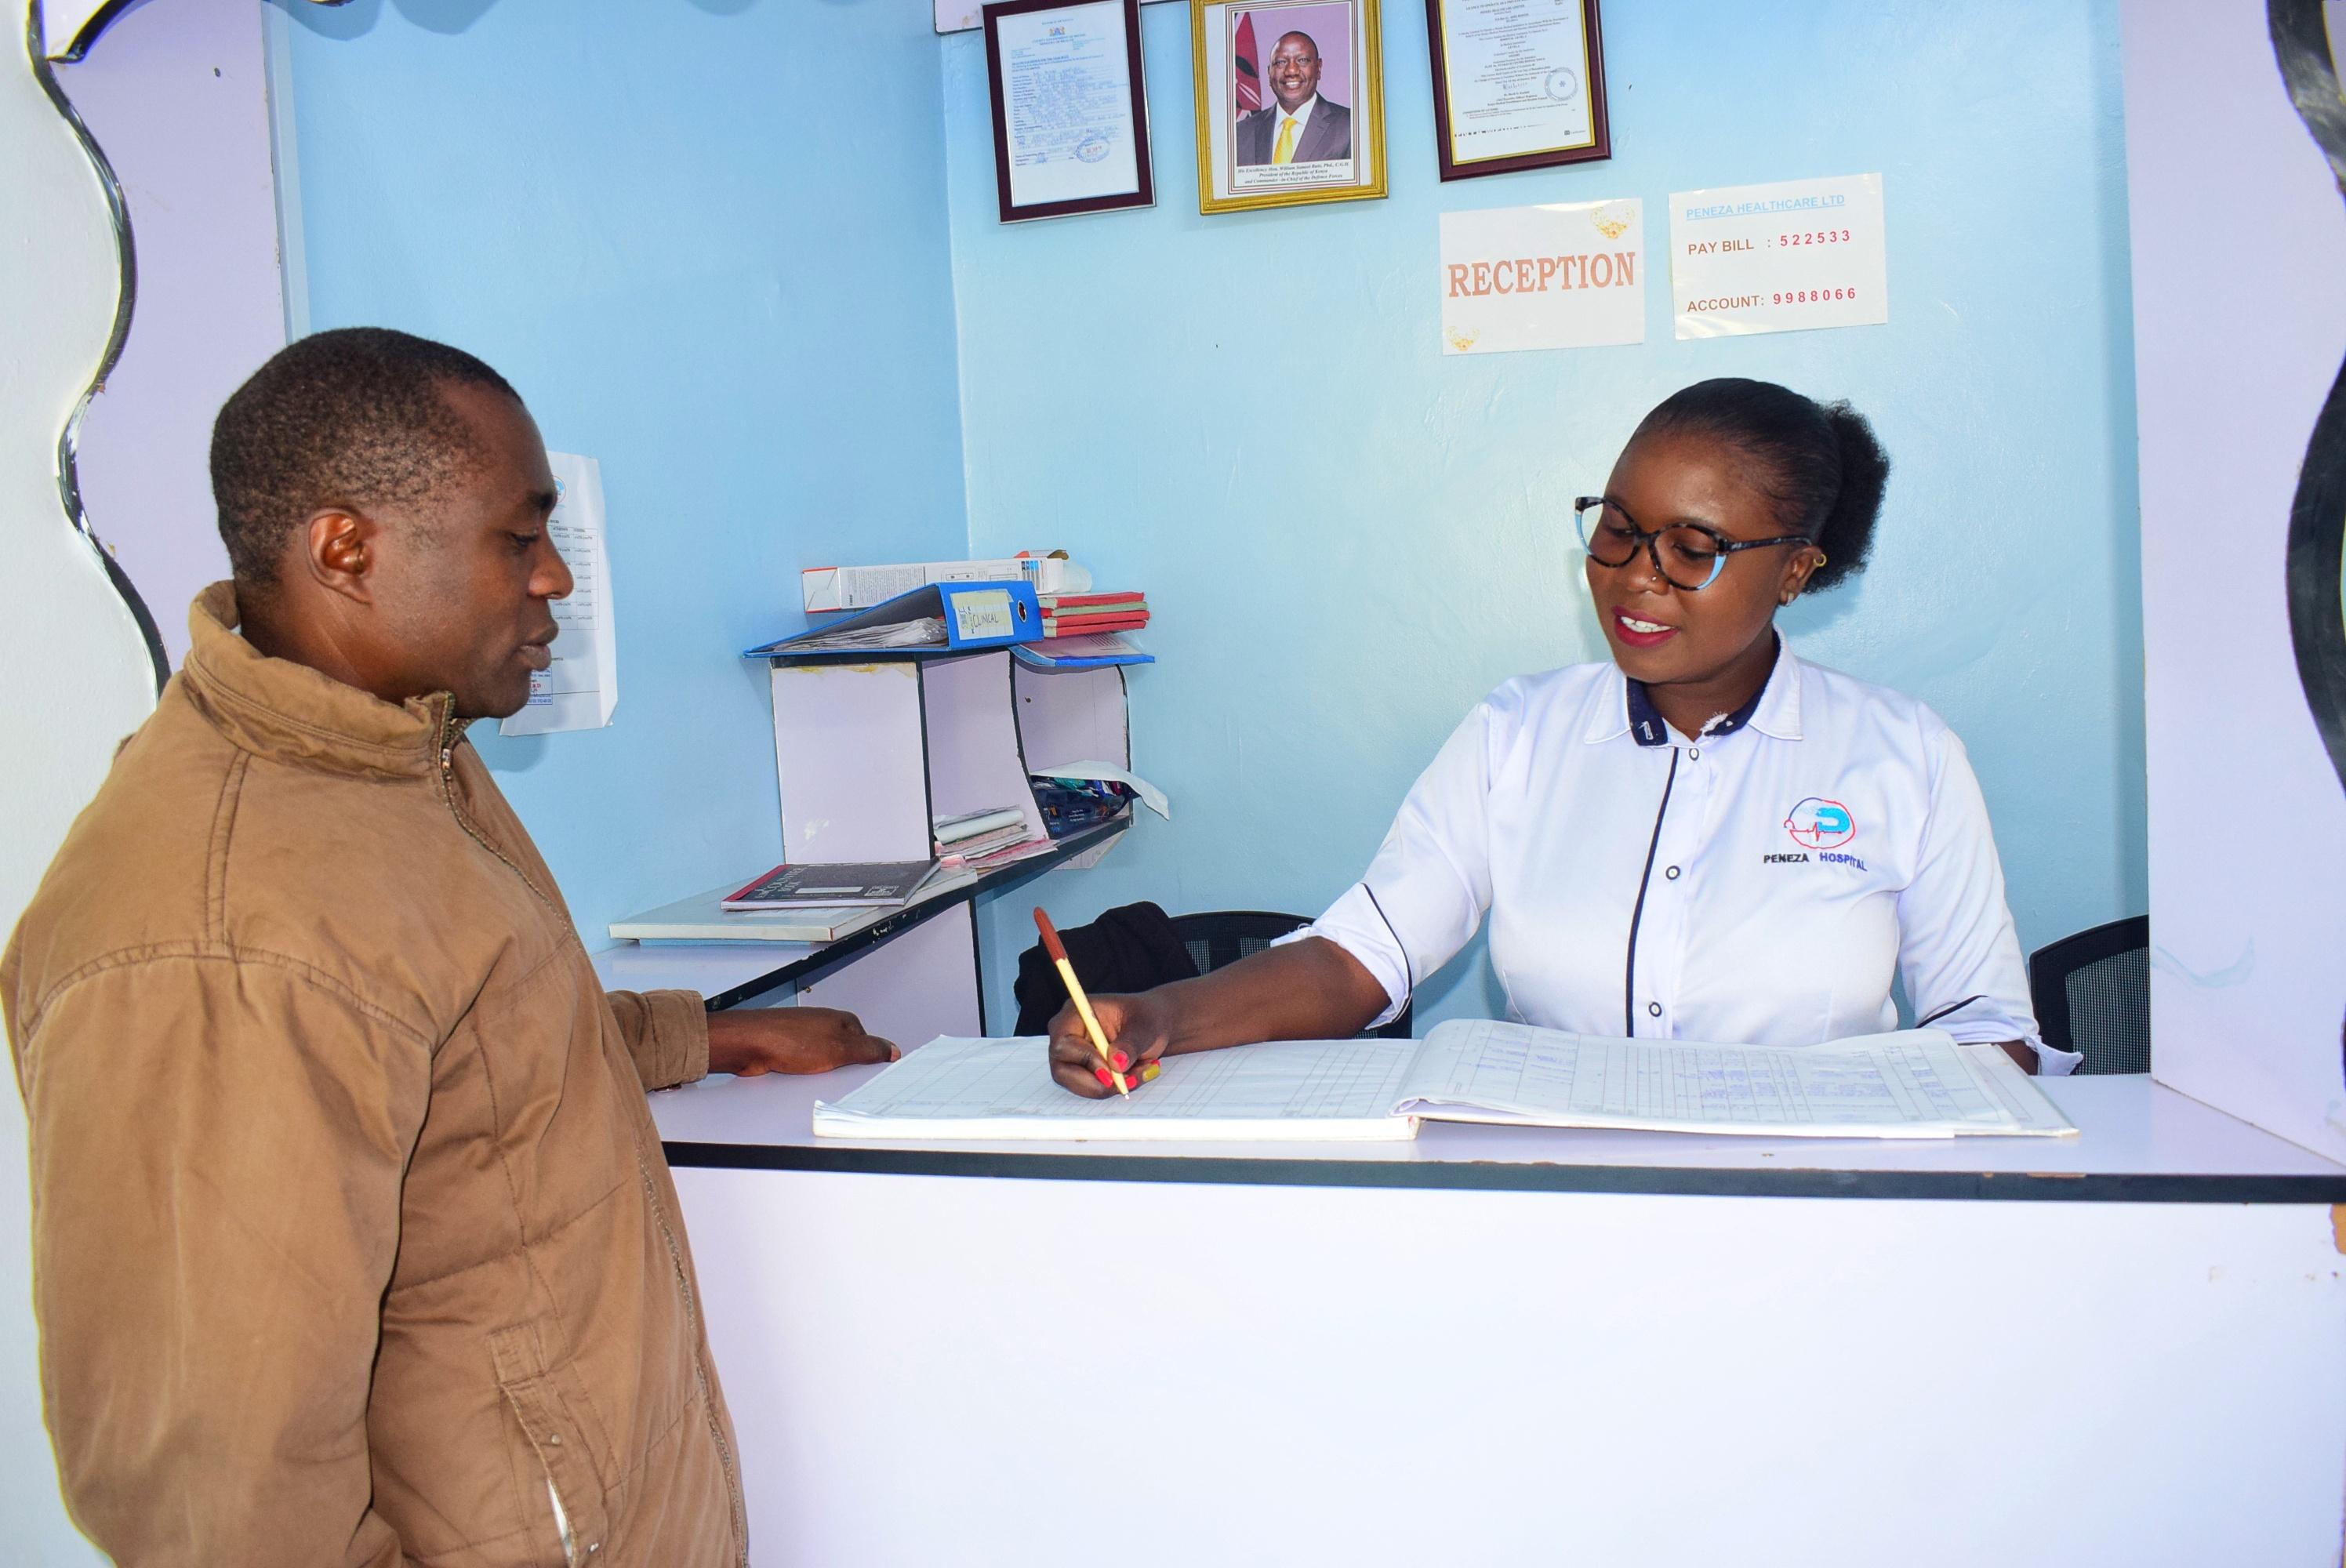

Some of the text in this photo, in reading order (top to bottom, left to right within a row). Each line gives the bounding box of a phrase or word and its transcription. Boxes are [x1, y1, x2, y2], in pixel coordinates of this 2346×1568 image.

[1687, 194, 1845, 218] PENEZA HEALTHCARE LTD
[1688, 241, 1718, 255] PAY
[1722, 239, 1754, 252] BILL
[1448, 252, 1636, 297] RECEPTION
[1687, 295, 1764, 312] ACCOUNT:
[1763, 852, 1868, 872] PENEZA HOSPITAL
